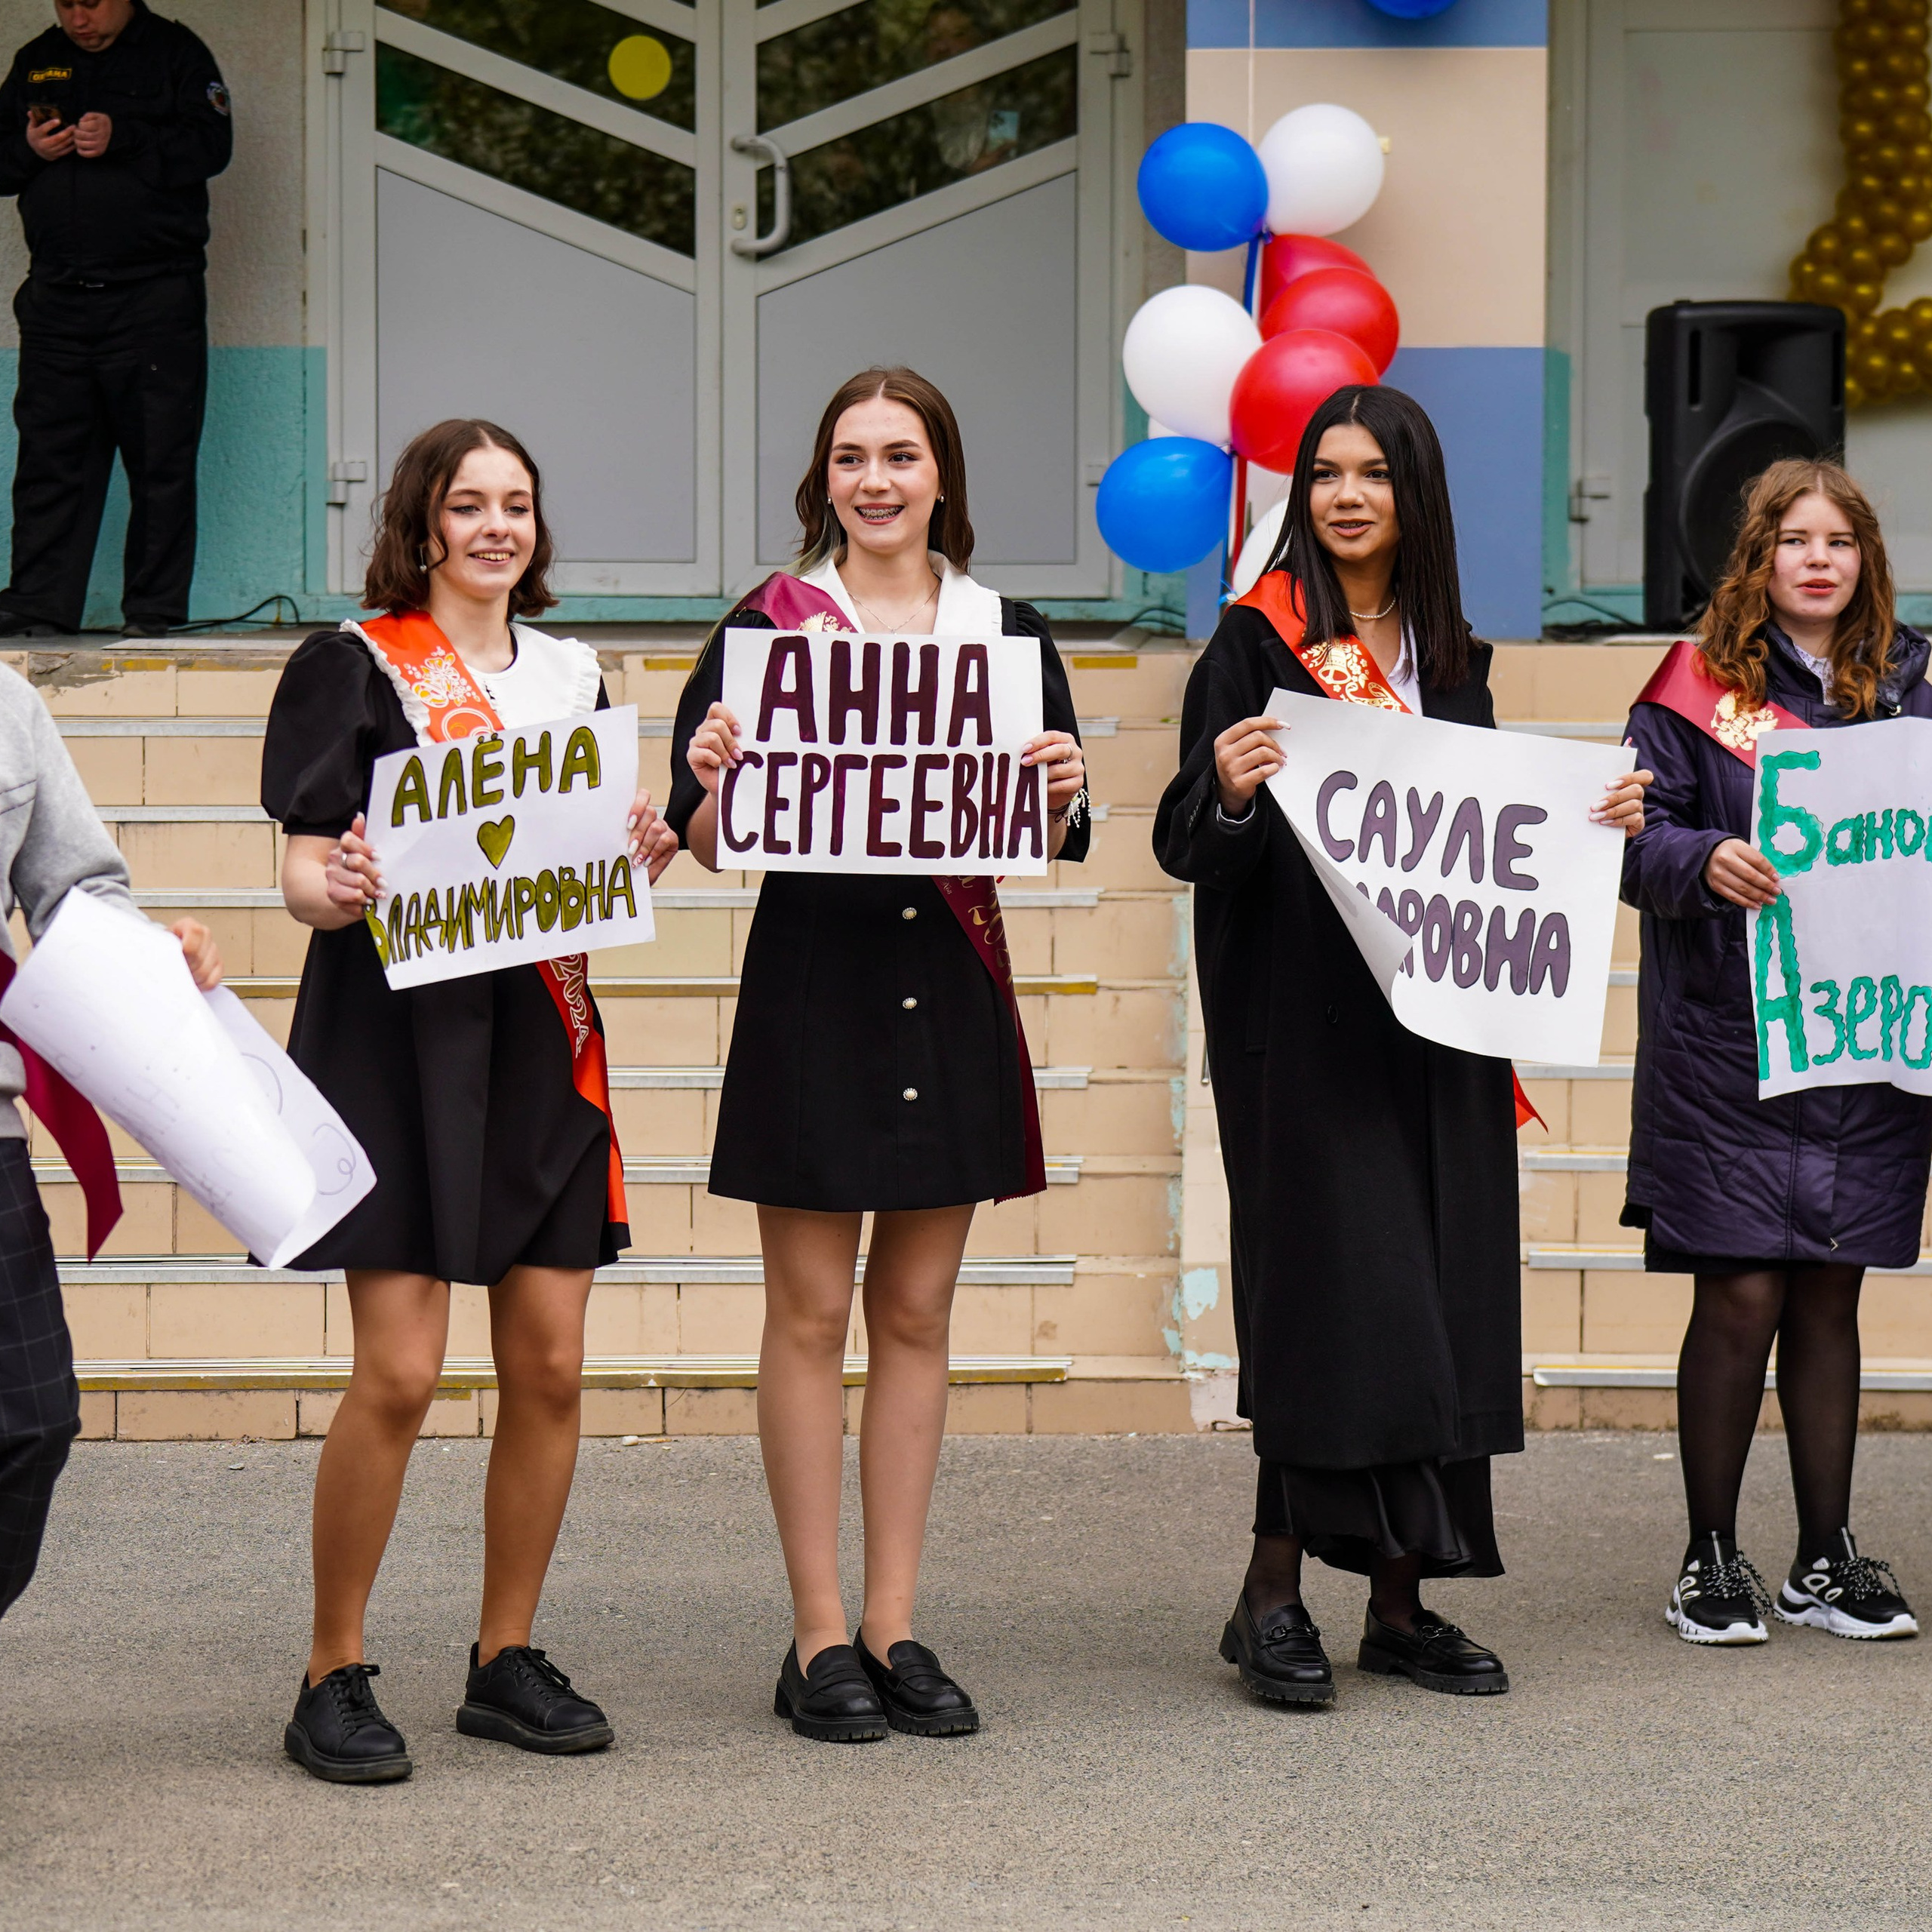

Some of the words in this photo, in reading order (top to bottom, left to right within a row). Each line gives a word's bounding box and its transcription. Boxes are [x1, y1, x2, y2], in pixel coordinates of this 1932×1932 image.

[755, 635, 993, 747] АННА
[391, 725, 601, 827] АЛЁНА
[721, 750, 1044, 859] СЕРГЕЕВНА
[1316, 770, 1548, 891] САУЛЕ
[1758, 750, 1932, 878] Бано
[365, 854, 637, 970] ВЛАДИМИРОВНА
[549, 953, 589, 1058] 2024
